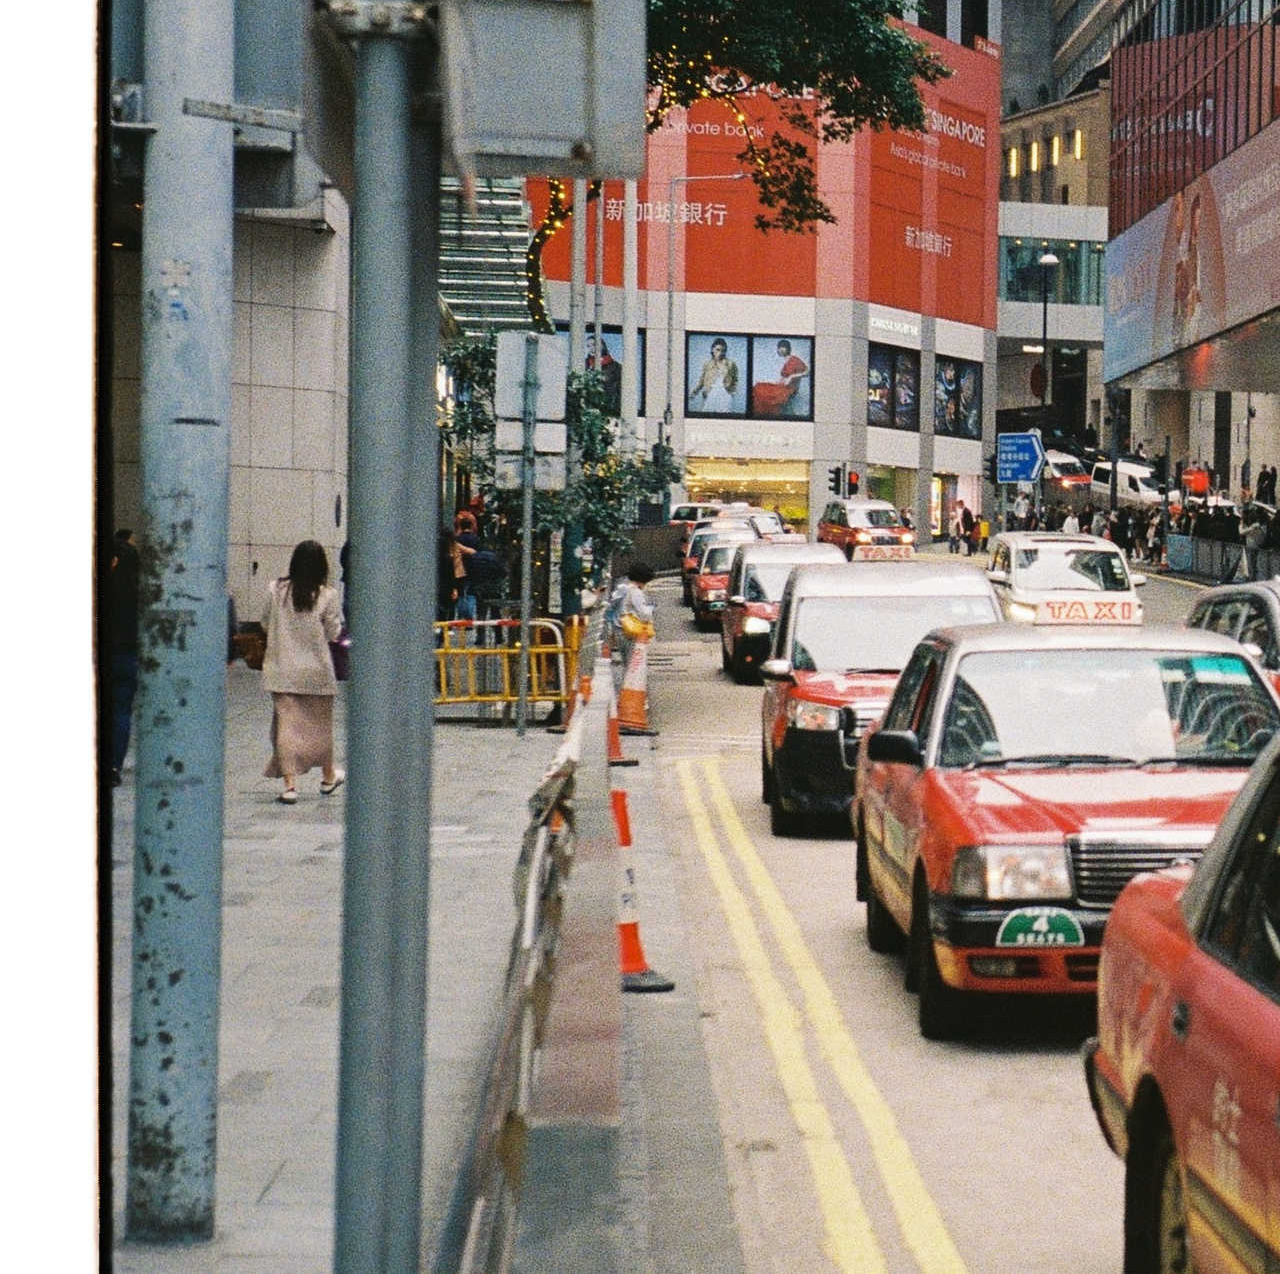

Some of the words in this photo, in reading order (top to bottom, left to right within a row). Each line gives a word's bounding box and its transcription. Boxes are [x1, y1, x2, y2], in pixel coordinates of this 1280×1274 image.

[725, 122, 764, 138] bank
[931, 110, 985, 148] SINGAPORE
[1046, 601, 1131, 620] TAXI
[1032, 915, 1049, 933] 4
